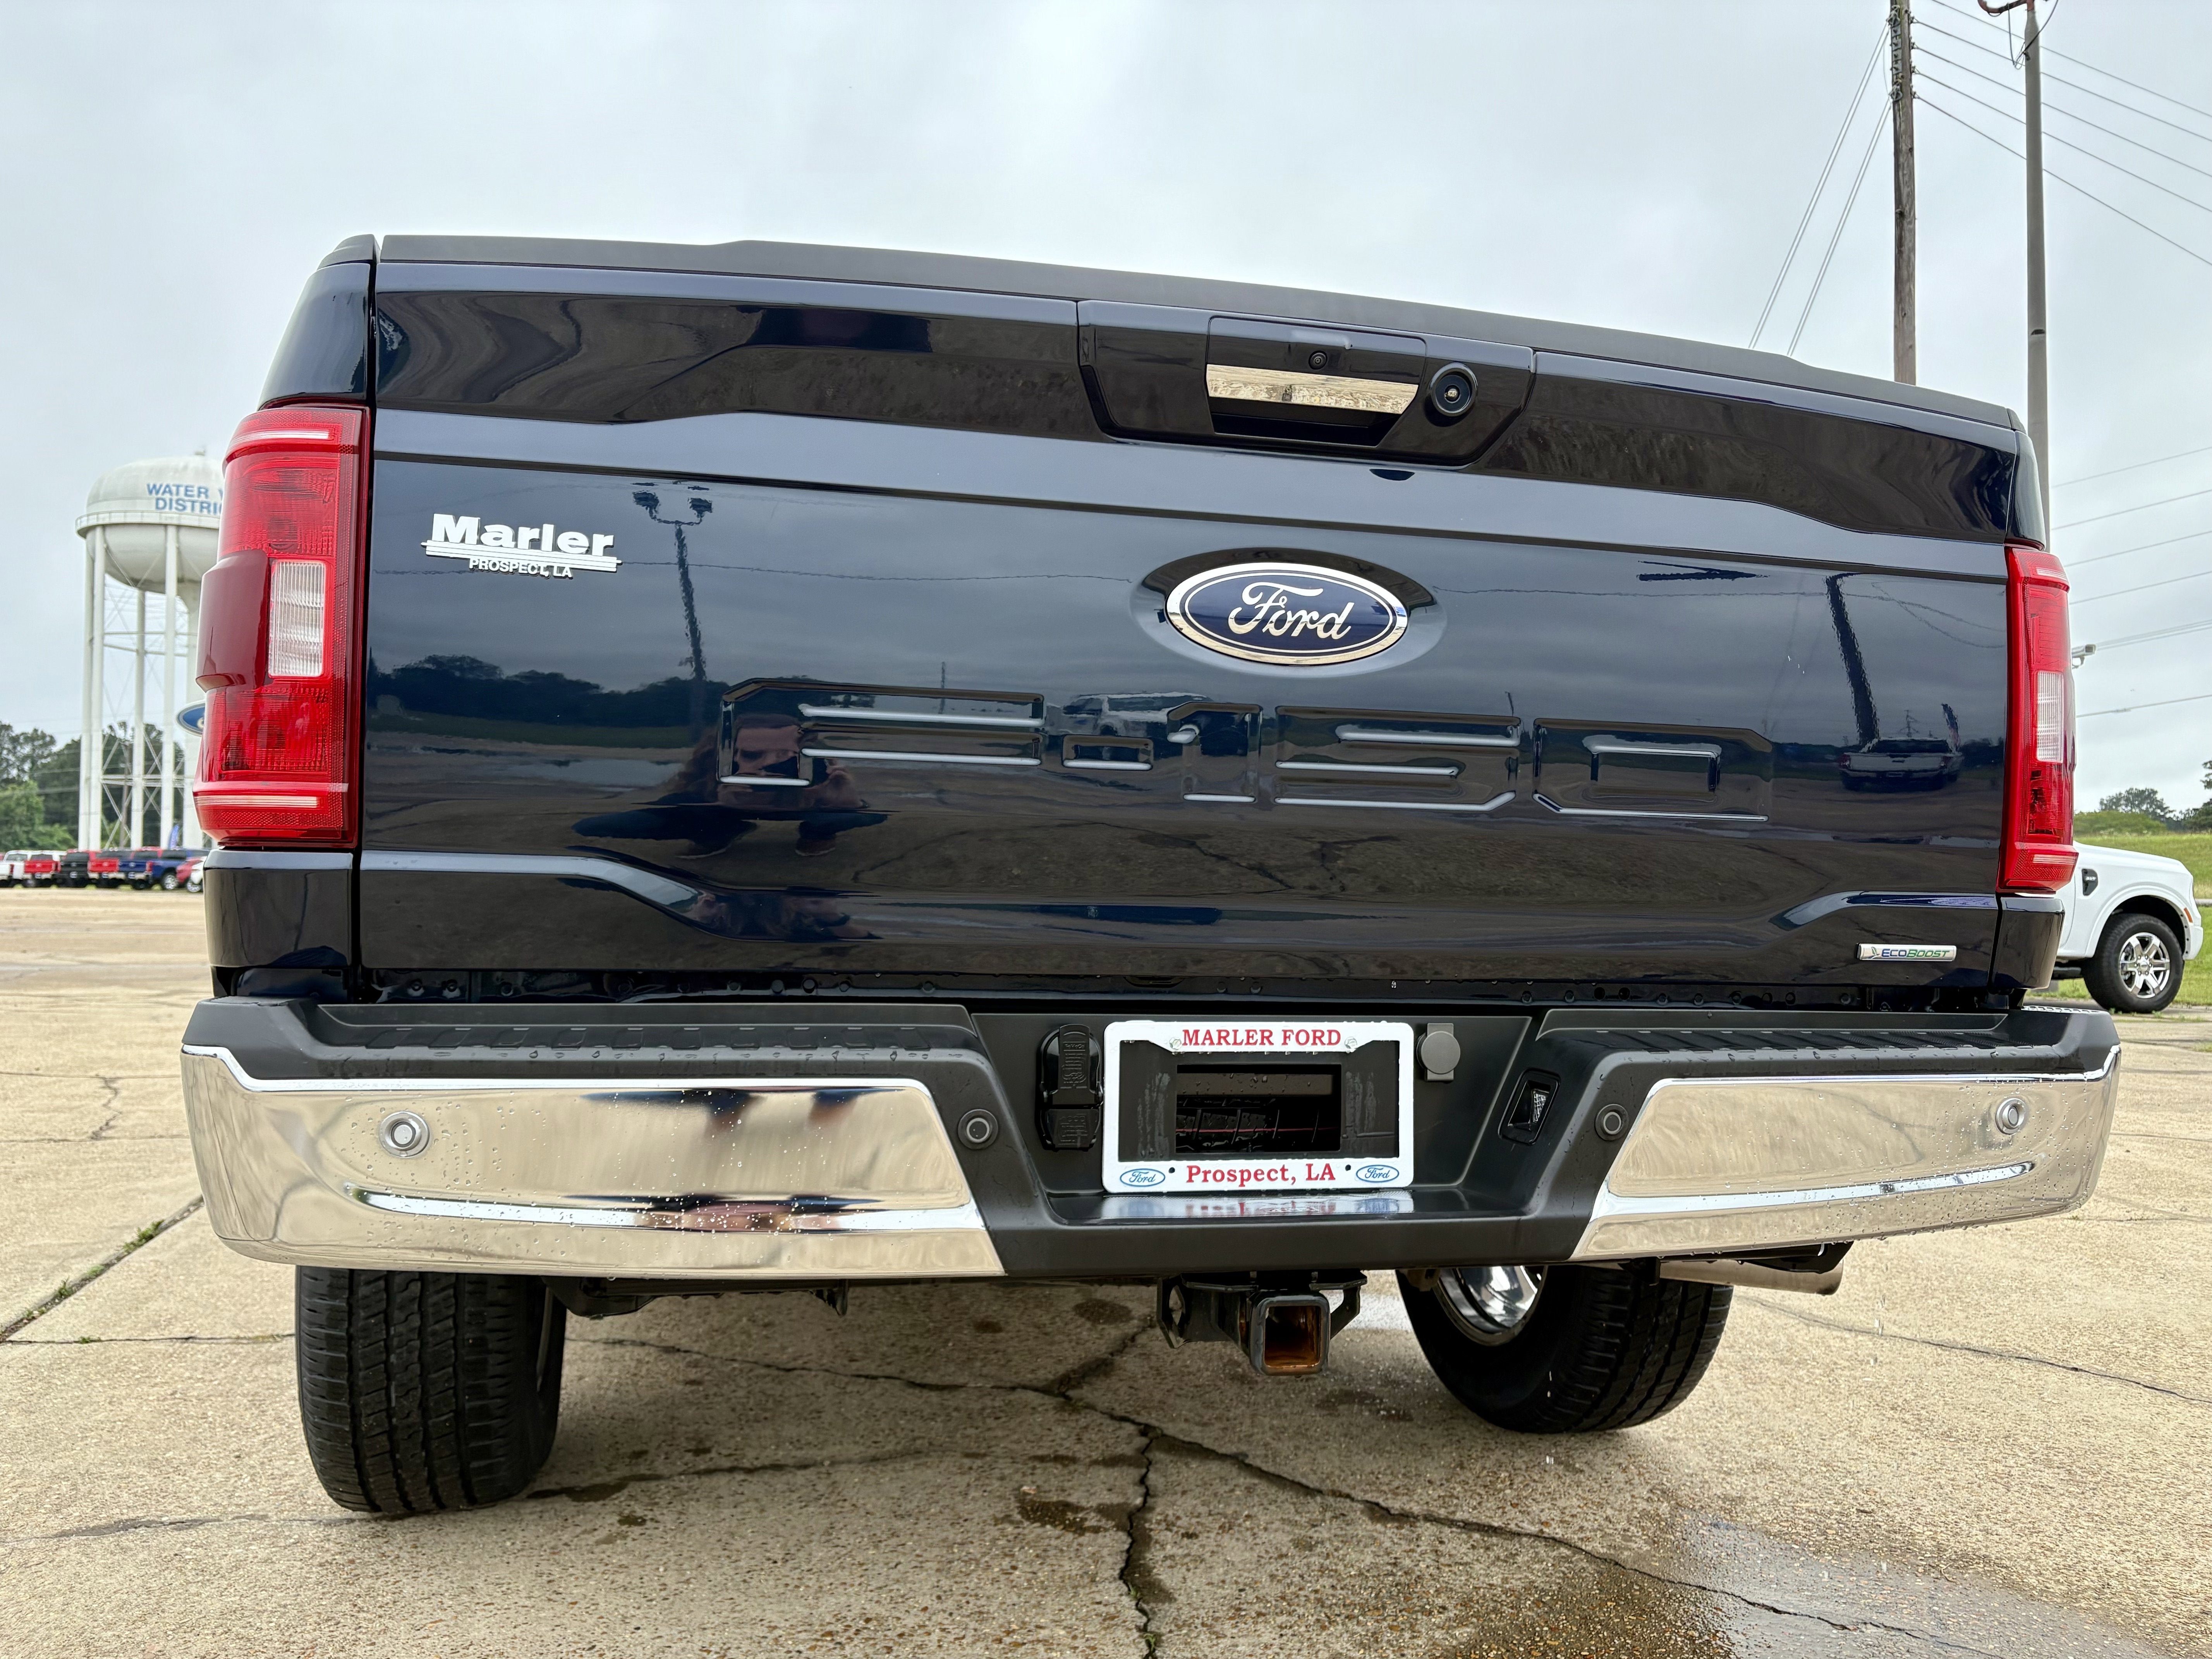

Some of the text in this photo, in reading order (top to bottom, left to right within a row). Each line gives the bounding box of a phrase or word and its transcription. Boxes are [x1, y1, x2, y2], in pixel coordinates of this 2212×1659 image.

[146, 483, 209, 499] WATER
[431, 514, 614, 556] Marler
[553, 565, 572, 578] LA
[1228, 581, 1355, 640] Ford
[1182, 1029, 1341, 1046] MARLER FORD
[1128, 1169, 1157, 1183] Ford
[1186, 1163, 1336, 1187] Prospect, LA
[1364, 1165, 1390, 1179] Ford
